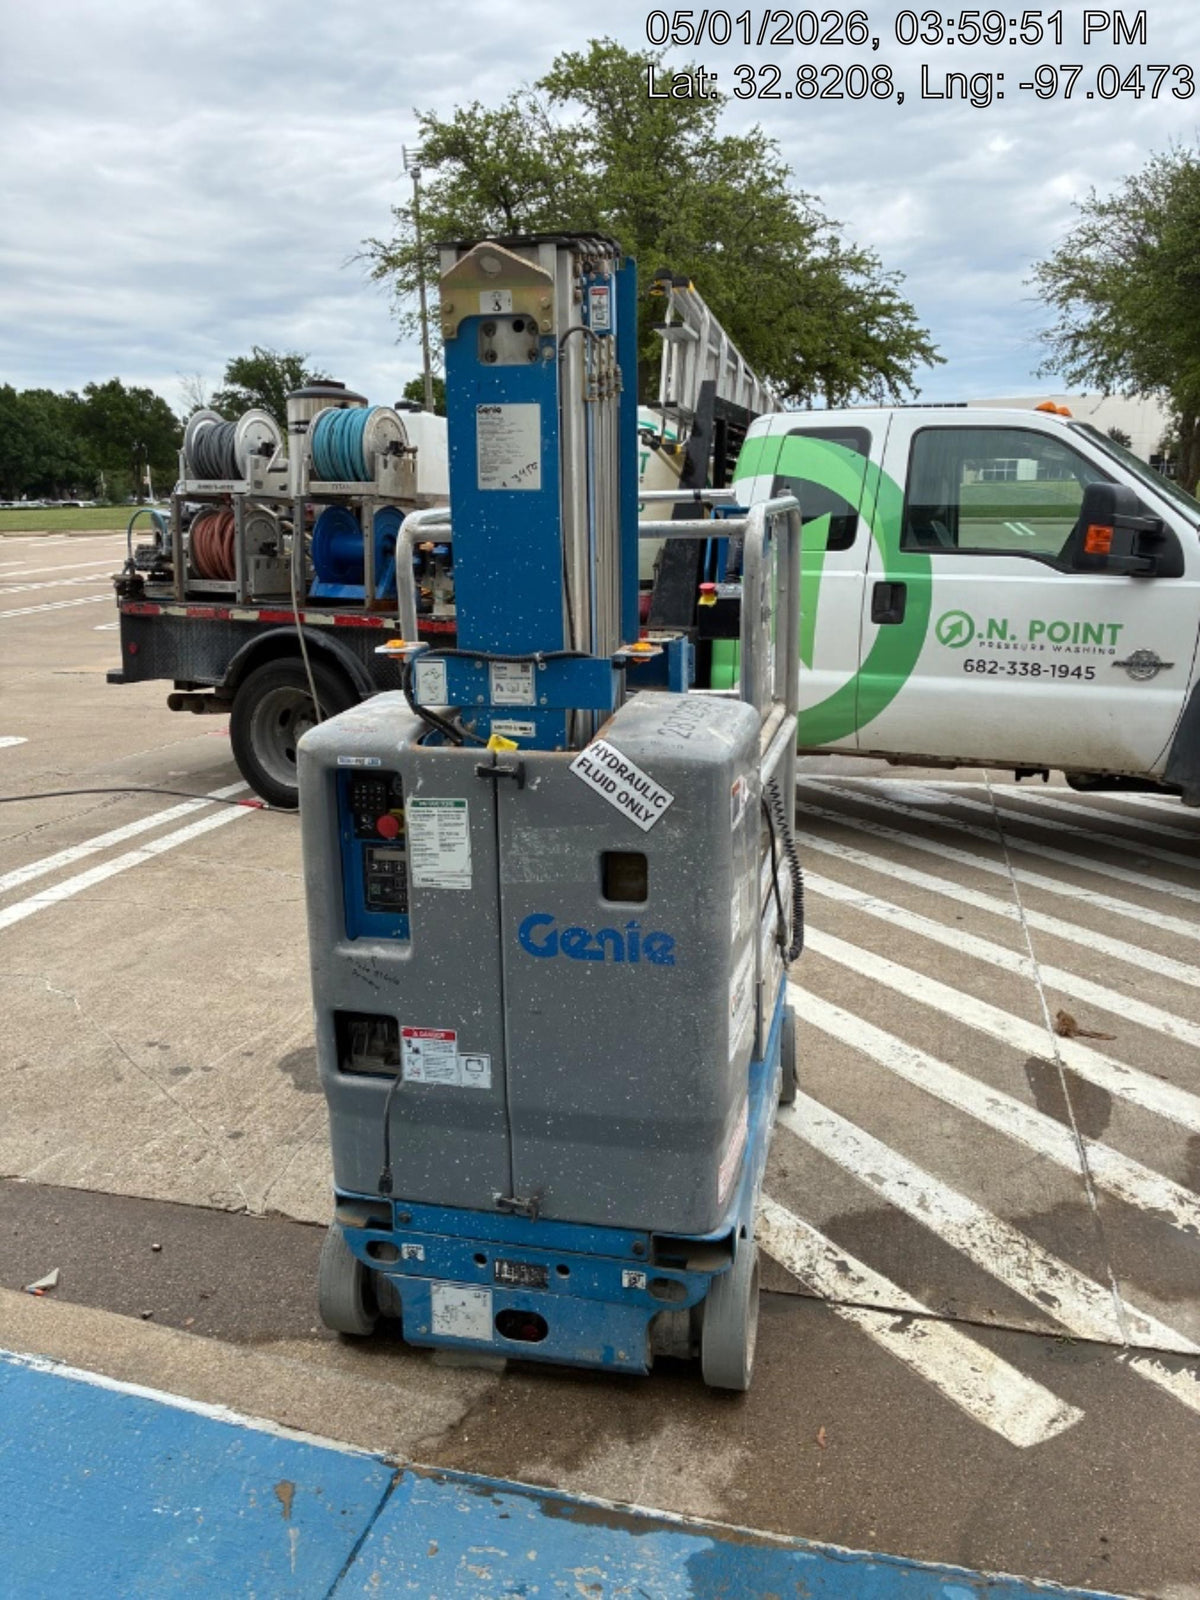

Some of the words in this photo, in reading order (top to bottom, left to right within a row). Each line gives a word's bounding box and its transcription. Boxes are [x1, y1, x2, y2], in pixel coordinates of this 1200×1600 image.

[978, 640, 1045, 651] PRESSURE
[1052, 645, 1117, 655] WASHING
[1029, 619, 1124, 646] POINT
[963, 658, 1096, 680] 682-338-1945
[576, 757, 617, 794] FLUID
[616, 791, 655, 823] ONLY
[591, 743, 668, 809] HYDRAULIC
[518, 913, 676, 967] Genie
